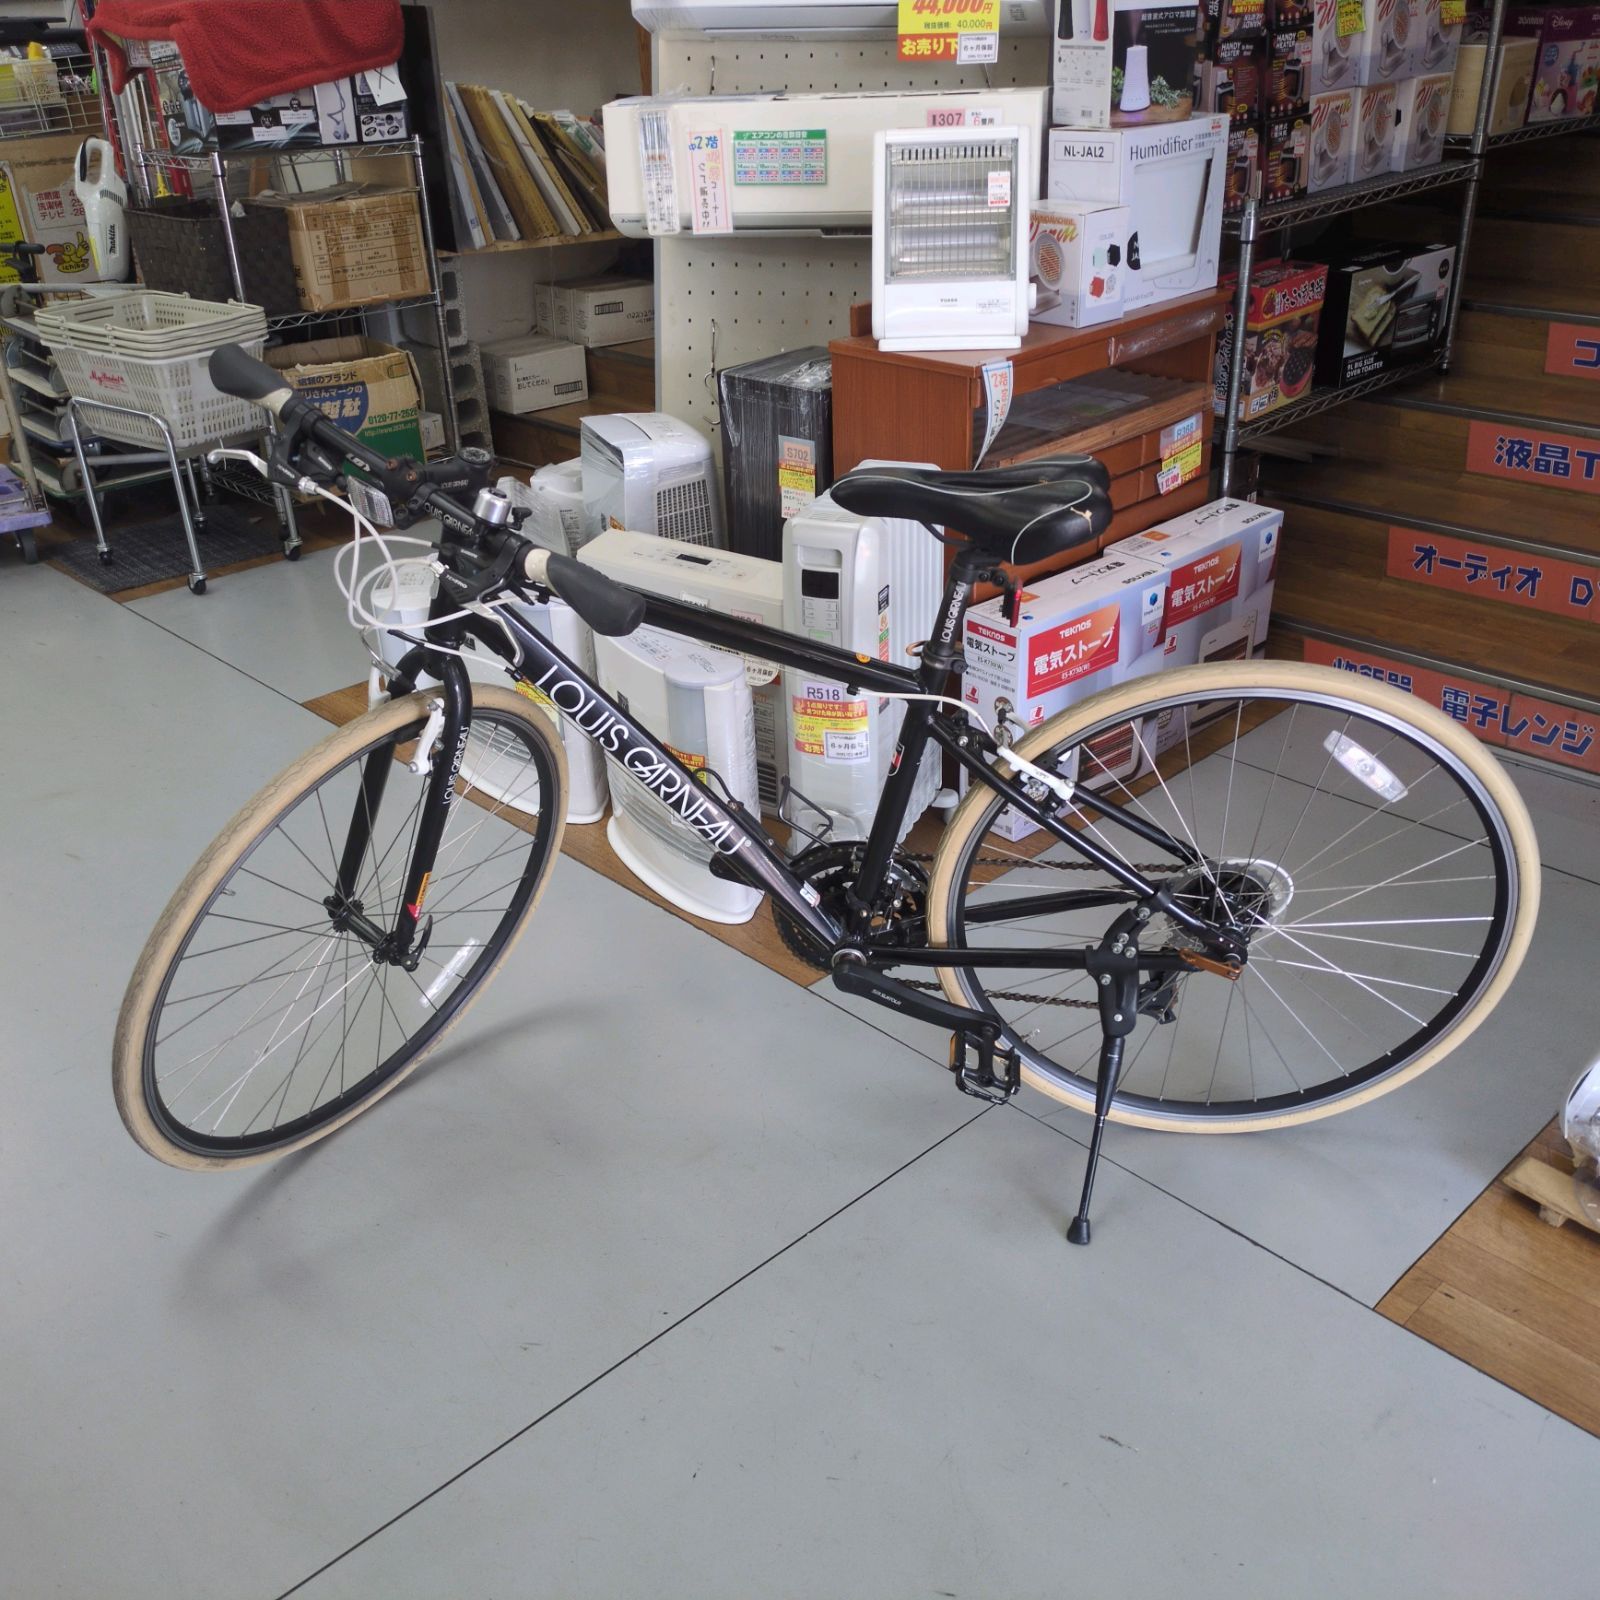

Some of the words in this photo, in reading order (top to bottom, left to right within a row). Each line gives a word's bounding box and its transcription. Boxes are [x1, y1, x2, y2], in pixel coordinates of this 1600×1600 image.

[912, 0, 993, 16] 44,000円
[1221, 41, 1241, 50] HANDY
[1276, 32, 1297, 41] HANDY
[1220, 49, 1240, 58] HEATER
[1063, 145, 1105, 160] NL-JAL2
[1130, 135, 1194, 161] Humidifier
[40, 210, 65, 221] テレビ
[1346, 368, 1361, 379] OVEN
[1361, 360, 1384, 374] TOASTER
[786, 447, 809, 461] S702
[1494, 435, 1600, 480] 液晶T
[423, 502, 443, 522] OUIS
[443, 513, 474, 537] GARNEA
[1193, 555, 1220, 574] TEKNOS
[1413, 544, 1542, 597] オーディオ
[1569, 576, 1600, 607] D
[1171, 562, 1238, 609] 電気ストーブ
[948, 580, 968, 618] GARNEAU
[941, 618, 956, 643] LOUIS
[977, 626, 1006, 642] TEKNOS
[1059, 618, 1092, 640] TEKNOS
[966, 636, 1017, 662] 電気ストーブ
[1033, 625, 1117, 677] 電気ストーブ
[806, 686, 840, 701] R518
[1441, 686, 1594, 756] 電子レンジ
[535, 665, 629, 752] LOUIS
[623, 747, 747, 856] GARNEAU
[442, 772, 458, 804] LOUIS
